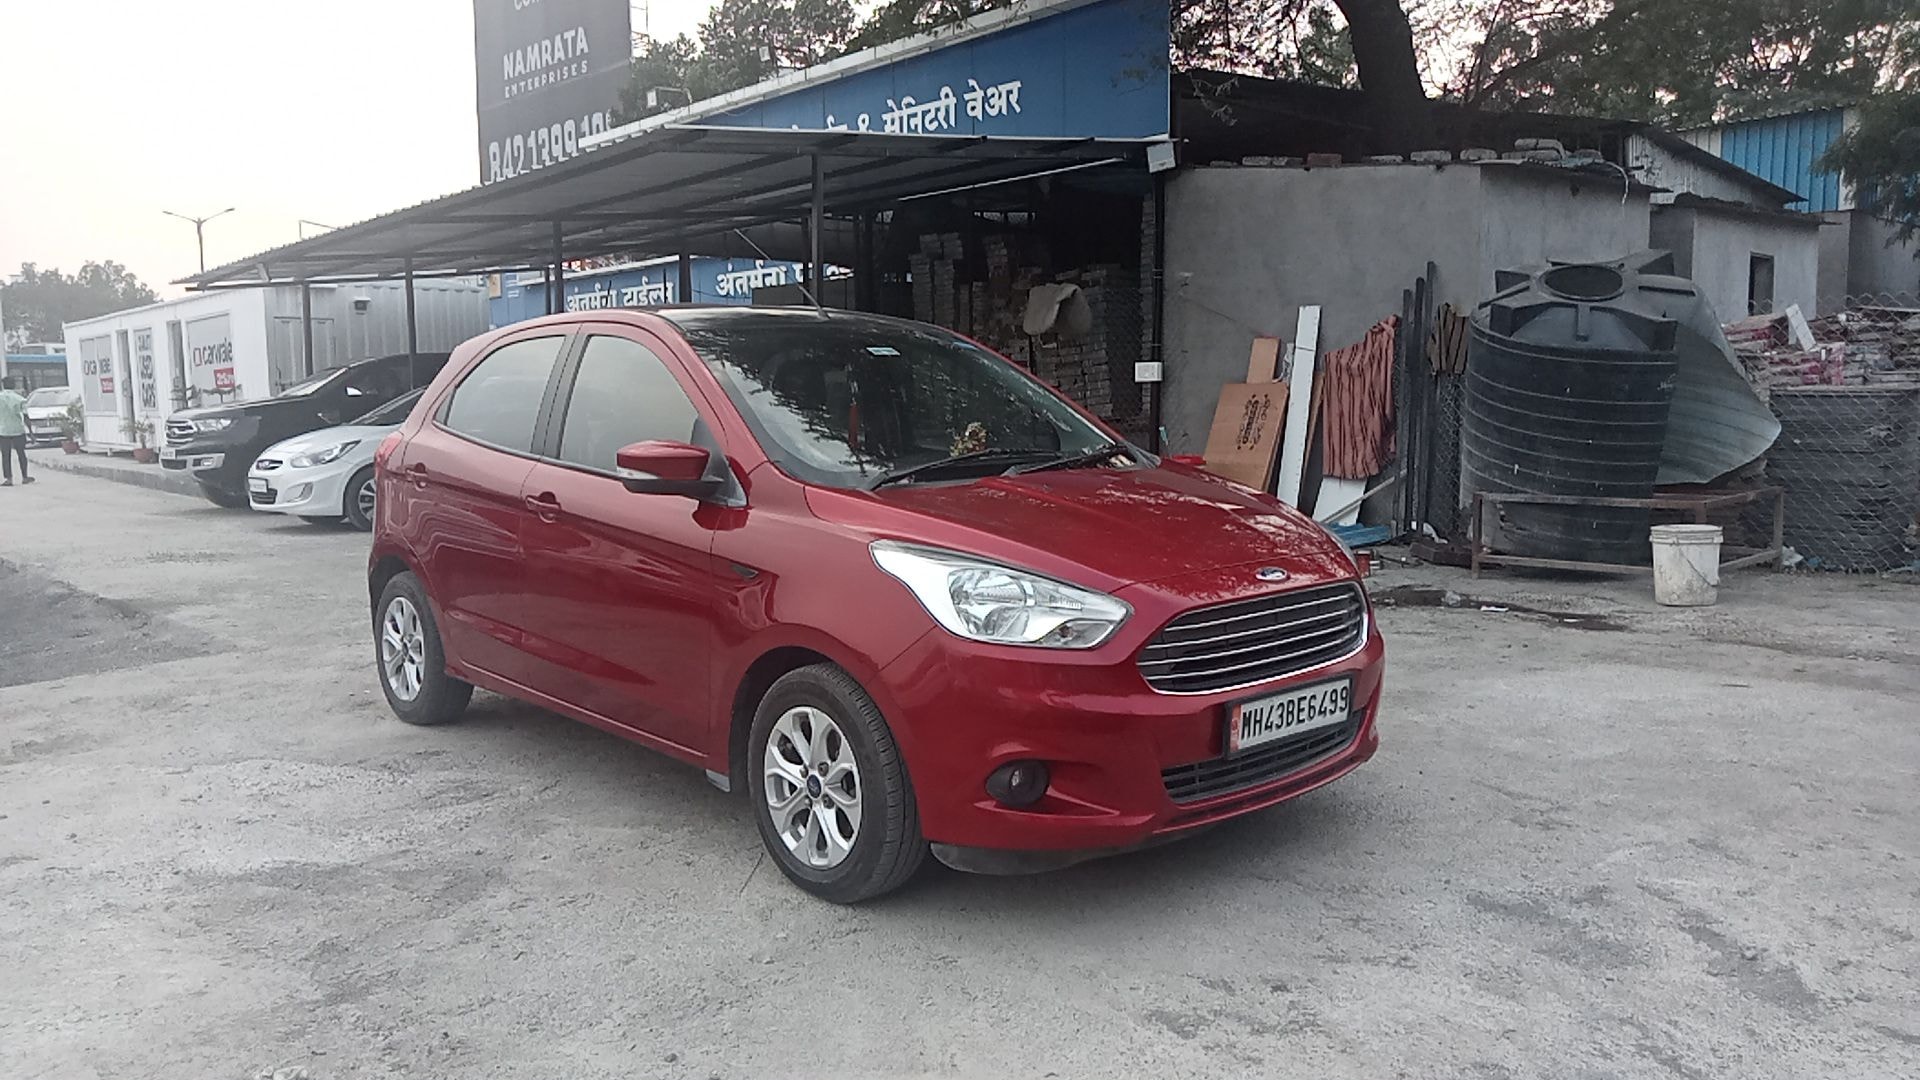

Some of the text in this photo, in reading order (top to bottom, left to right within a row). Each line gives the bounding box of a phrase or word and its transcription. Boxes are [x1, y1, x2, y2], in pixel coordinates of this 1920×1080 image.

[503, 26, 589, 81] NAMRATA
[504, 60, 588, 98] ENTERPRISES
[963, 78, 1022, 122] वेअर
[1241, 686, 1350, 741] MH43BE6499
